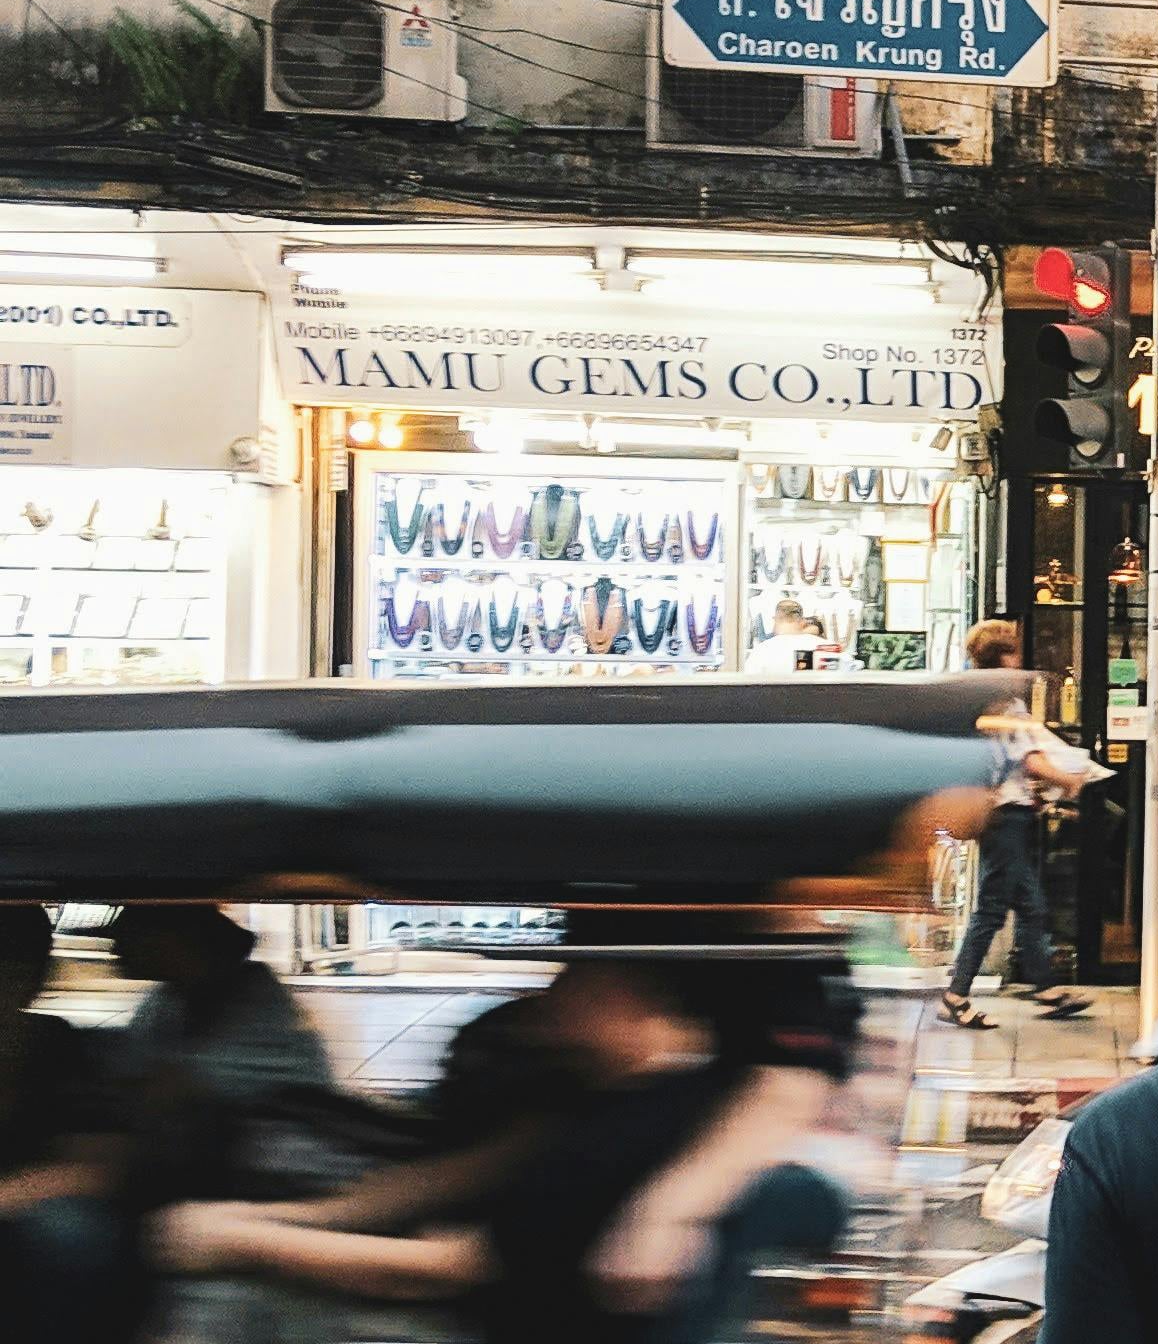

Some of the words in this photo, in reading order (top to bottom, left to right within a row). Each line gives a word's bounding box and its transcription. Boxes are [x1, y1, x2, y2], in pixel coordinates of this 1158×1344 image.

[717, 31, 838, 61] Charoen
[855, 40, 943, 71] Krung
[959, 45, 1006, 71] Rd.
[285, 320, 360, 341] Mobile
[951, 327, 988, 342] 1372
[822, 342, 880, 366] Shop
[886, 345, 924, 364] No.
[933, 348, 985, 366] 1372
[296, 346, 505, 393] MAMU
[528, 353, 708, 400] GEMS
